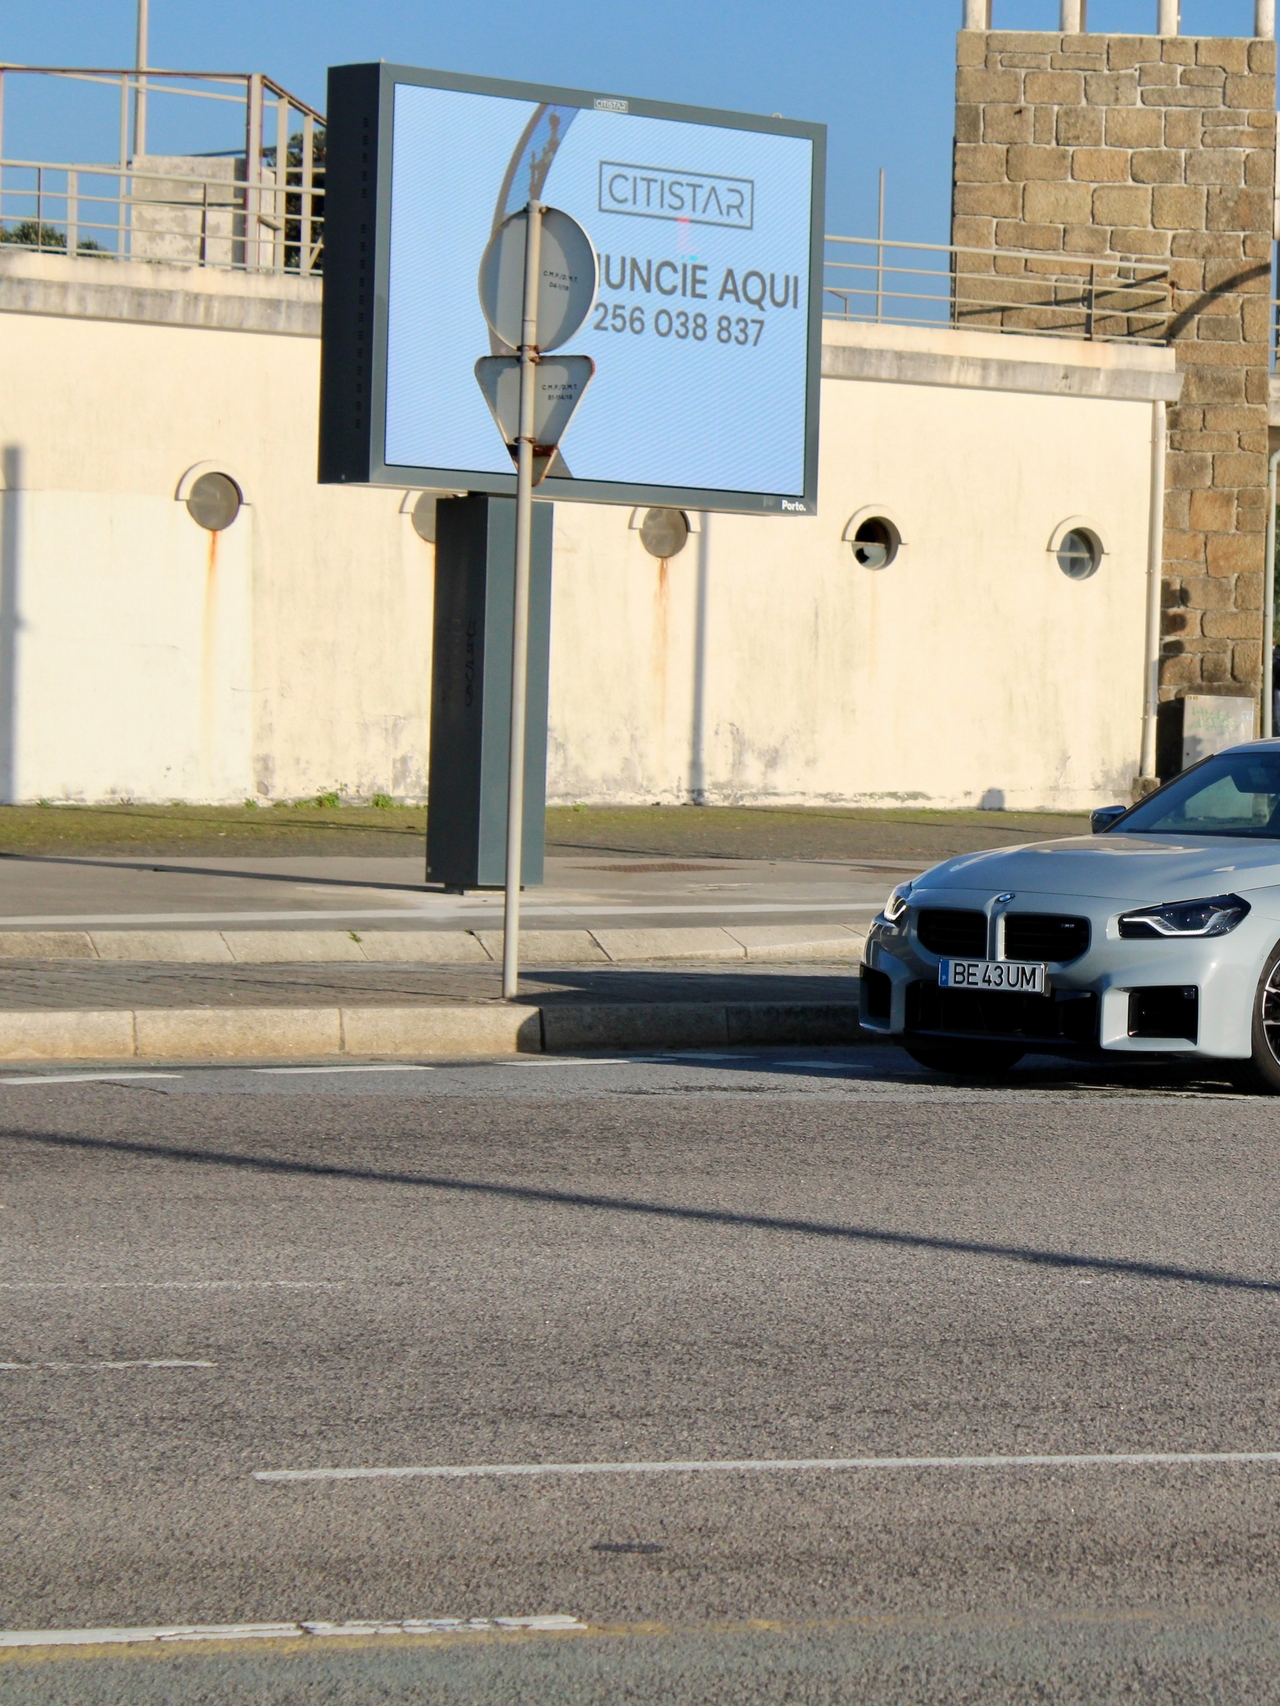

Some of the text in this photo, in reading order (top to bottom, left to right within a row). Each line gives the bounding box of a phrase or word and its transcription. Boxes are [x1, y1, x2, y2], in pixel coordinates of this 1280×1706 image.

[595, 99, 627, 111] CITISTAR
[608, 173, 745, 219] CITISTAR
[718, 268, 799, 312] AQUI
[593, 302, 765, 347] 256 038 837
[781, 499, 807, 512] Porto.
